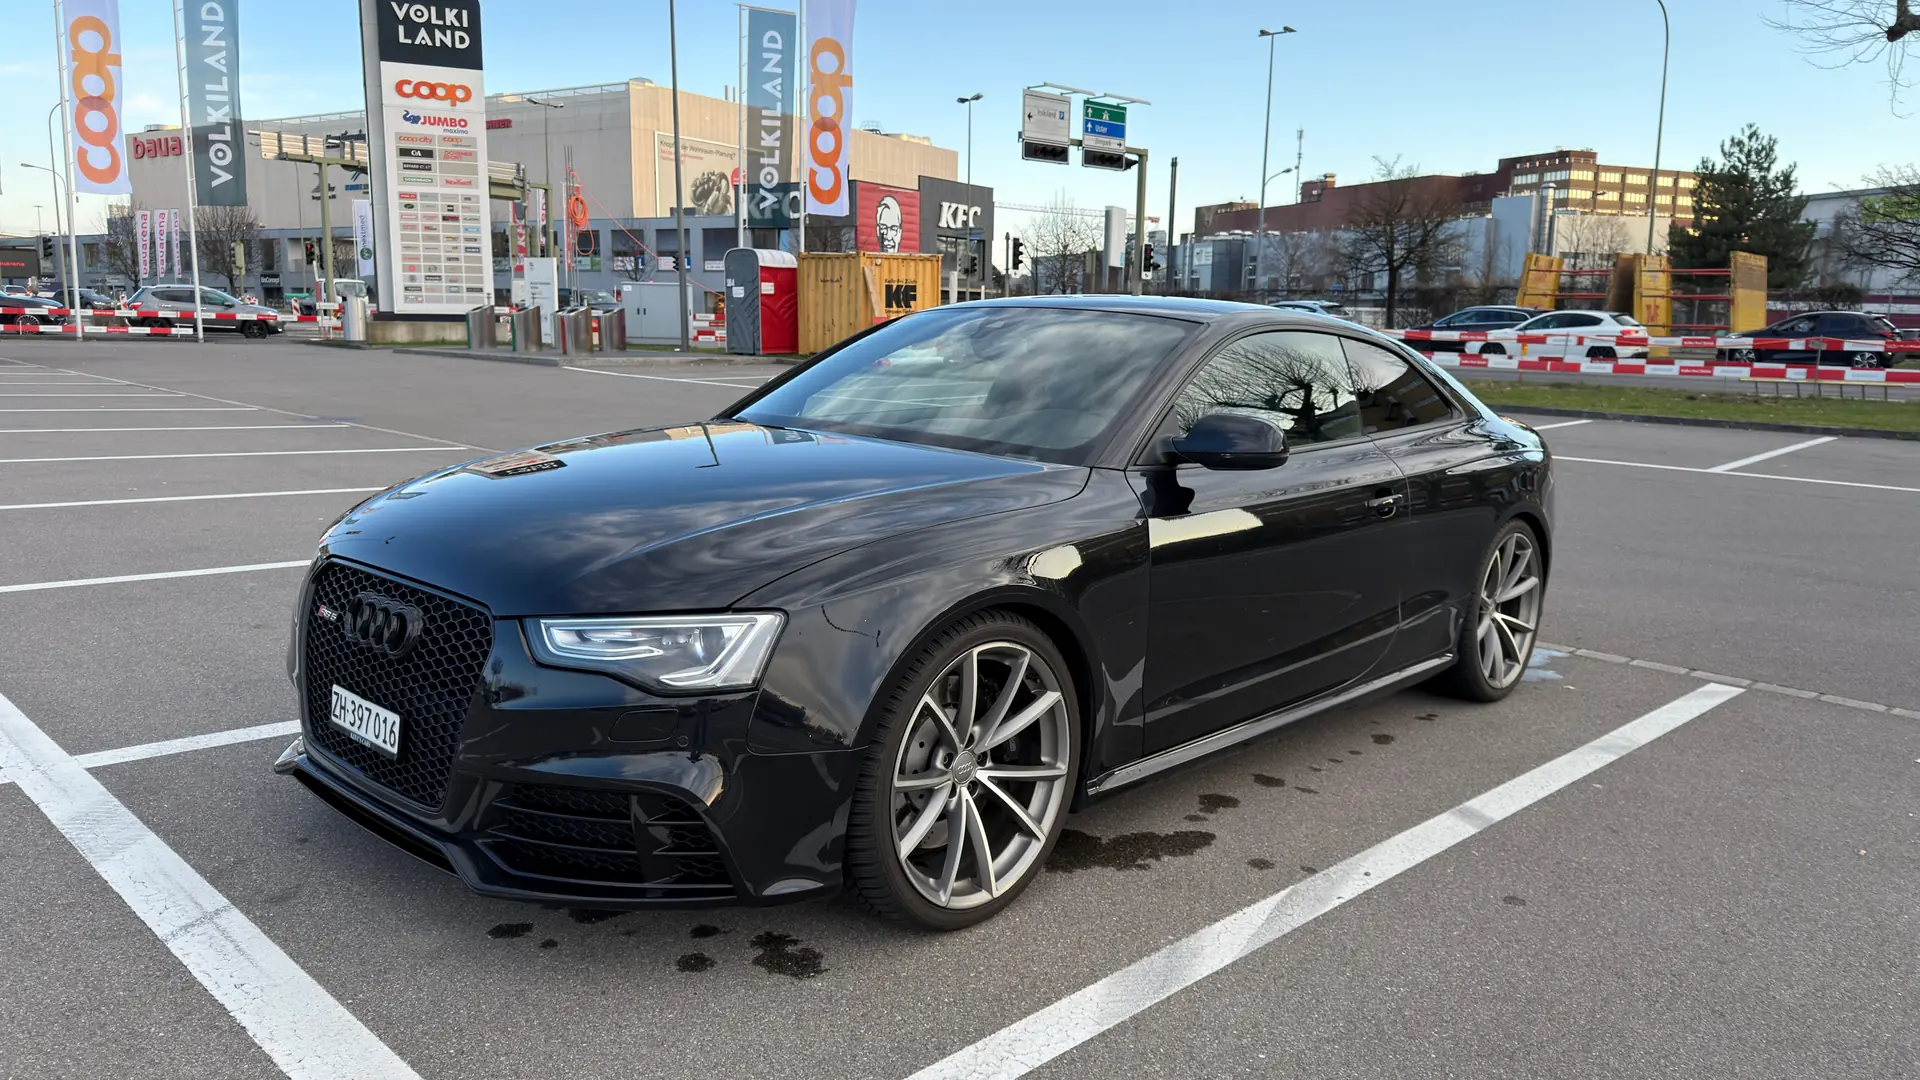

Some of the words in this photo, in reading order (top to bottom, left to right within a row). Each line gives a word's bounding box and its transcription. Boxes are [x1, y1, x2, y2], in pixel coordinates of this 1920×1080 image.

[391, 1, 468, 28] VOLKI
[398, 25, 470, 49] LAND
[69, 15, 122, 185] coop
[201, 1, 234, 188] VOLKILAND
[395, 79, 472, 107] coop
[420, 115, 468, 128] JUMBO
[759, 30, 783, 210] VOLKILAND
[808, 37, 853, 205] coop
[938, 201, 982, 228] KFC
[885, 285, 917, 308] KF
